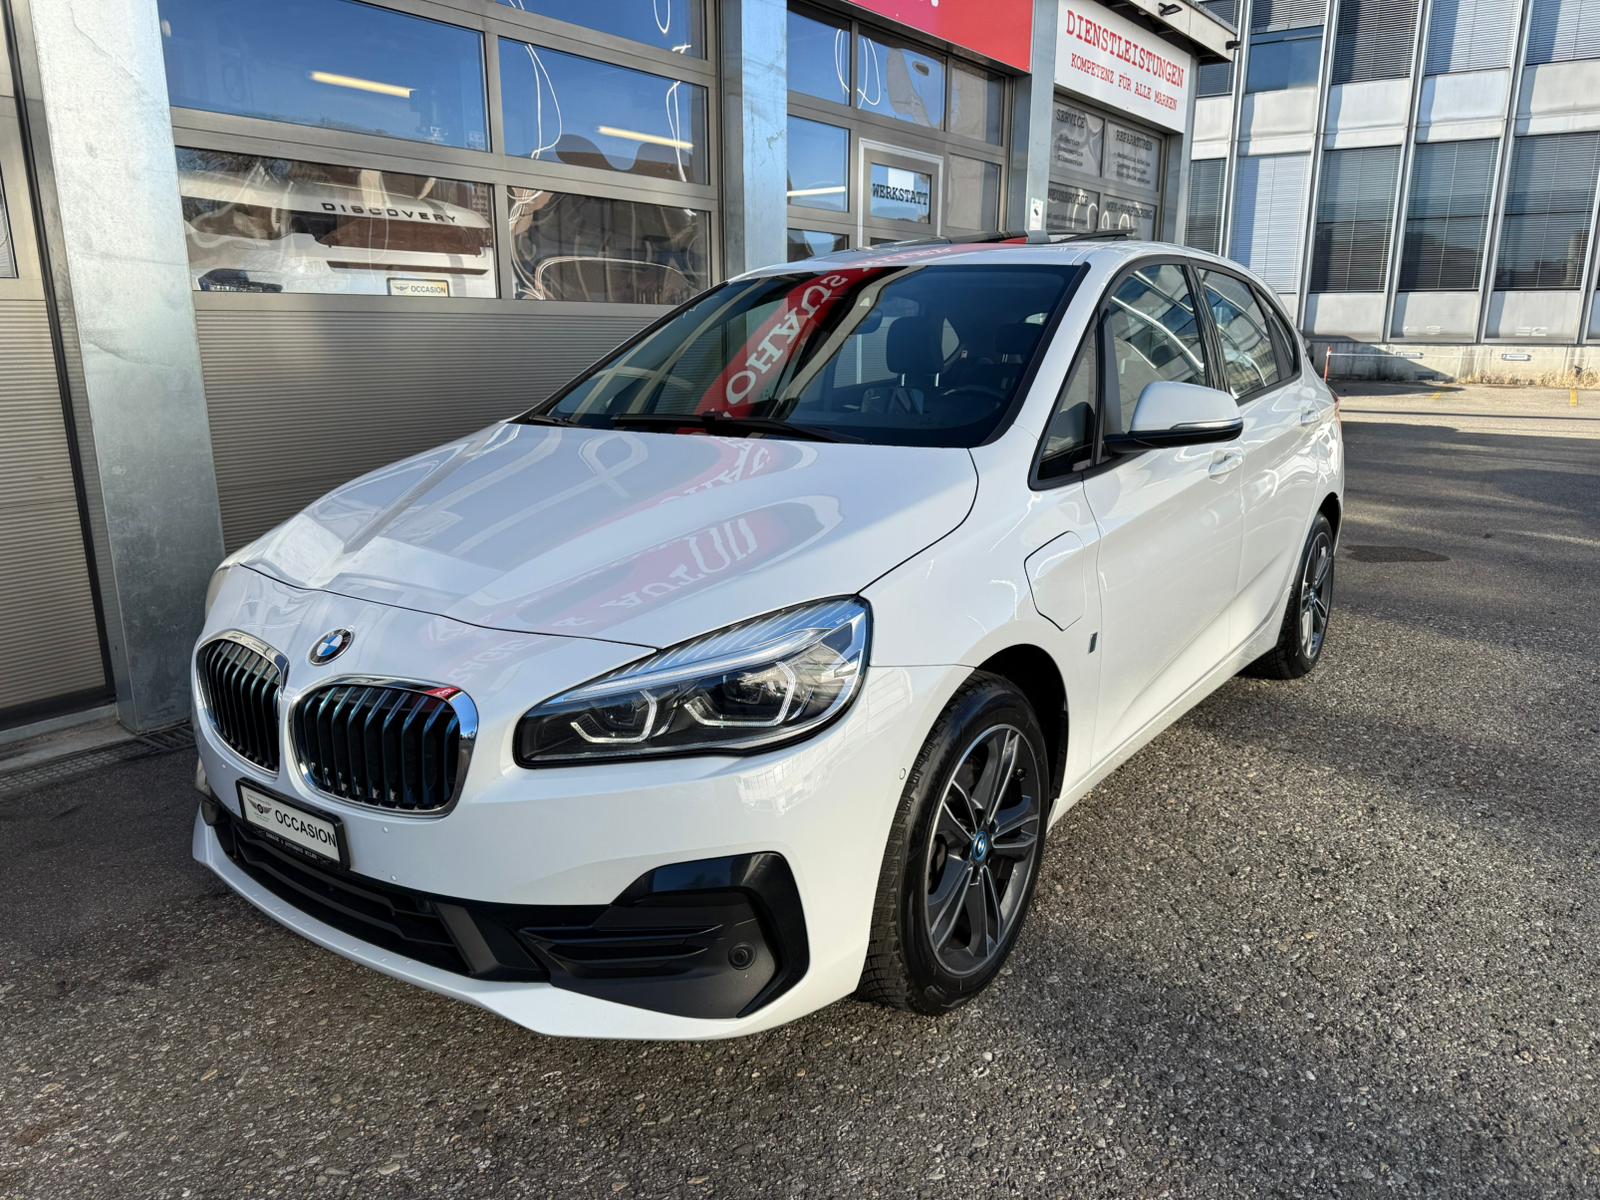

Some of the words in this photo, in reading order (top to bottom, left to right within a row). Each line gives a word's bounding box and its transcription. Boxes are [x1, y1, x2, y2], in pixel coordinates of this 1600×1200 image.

[1066, 10, 1185, 88] DIENSTLEISTUNGEN
[1071, 52, 1115, 84] KOMPETENZ
[1118, 72, 1132, 92] FÜR
[1134, 82, 1152, 101] ALLE
[1154, 91, 1178, 112] MARKEN
[1056, 109, 1086, 129] SERVICE
[871, 183, 928, 206] WERKSTATT
[321, 202, 457, 224] DISCOVERY
[410, 285, 447, 294] OCCASION
[275, 809, 337, 848] OCCASION
